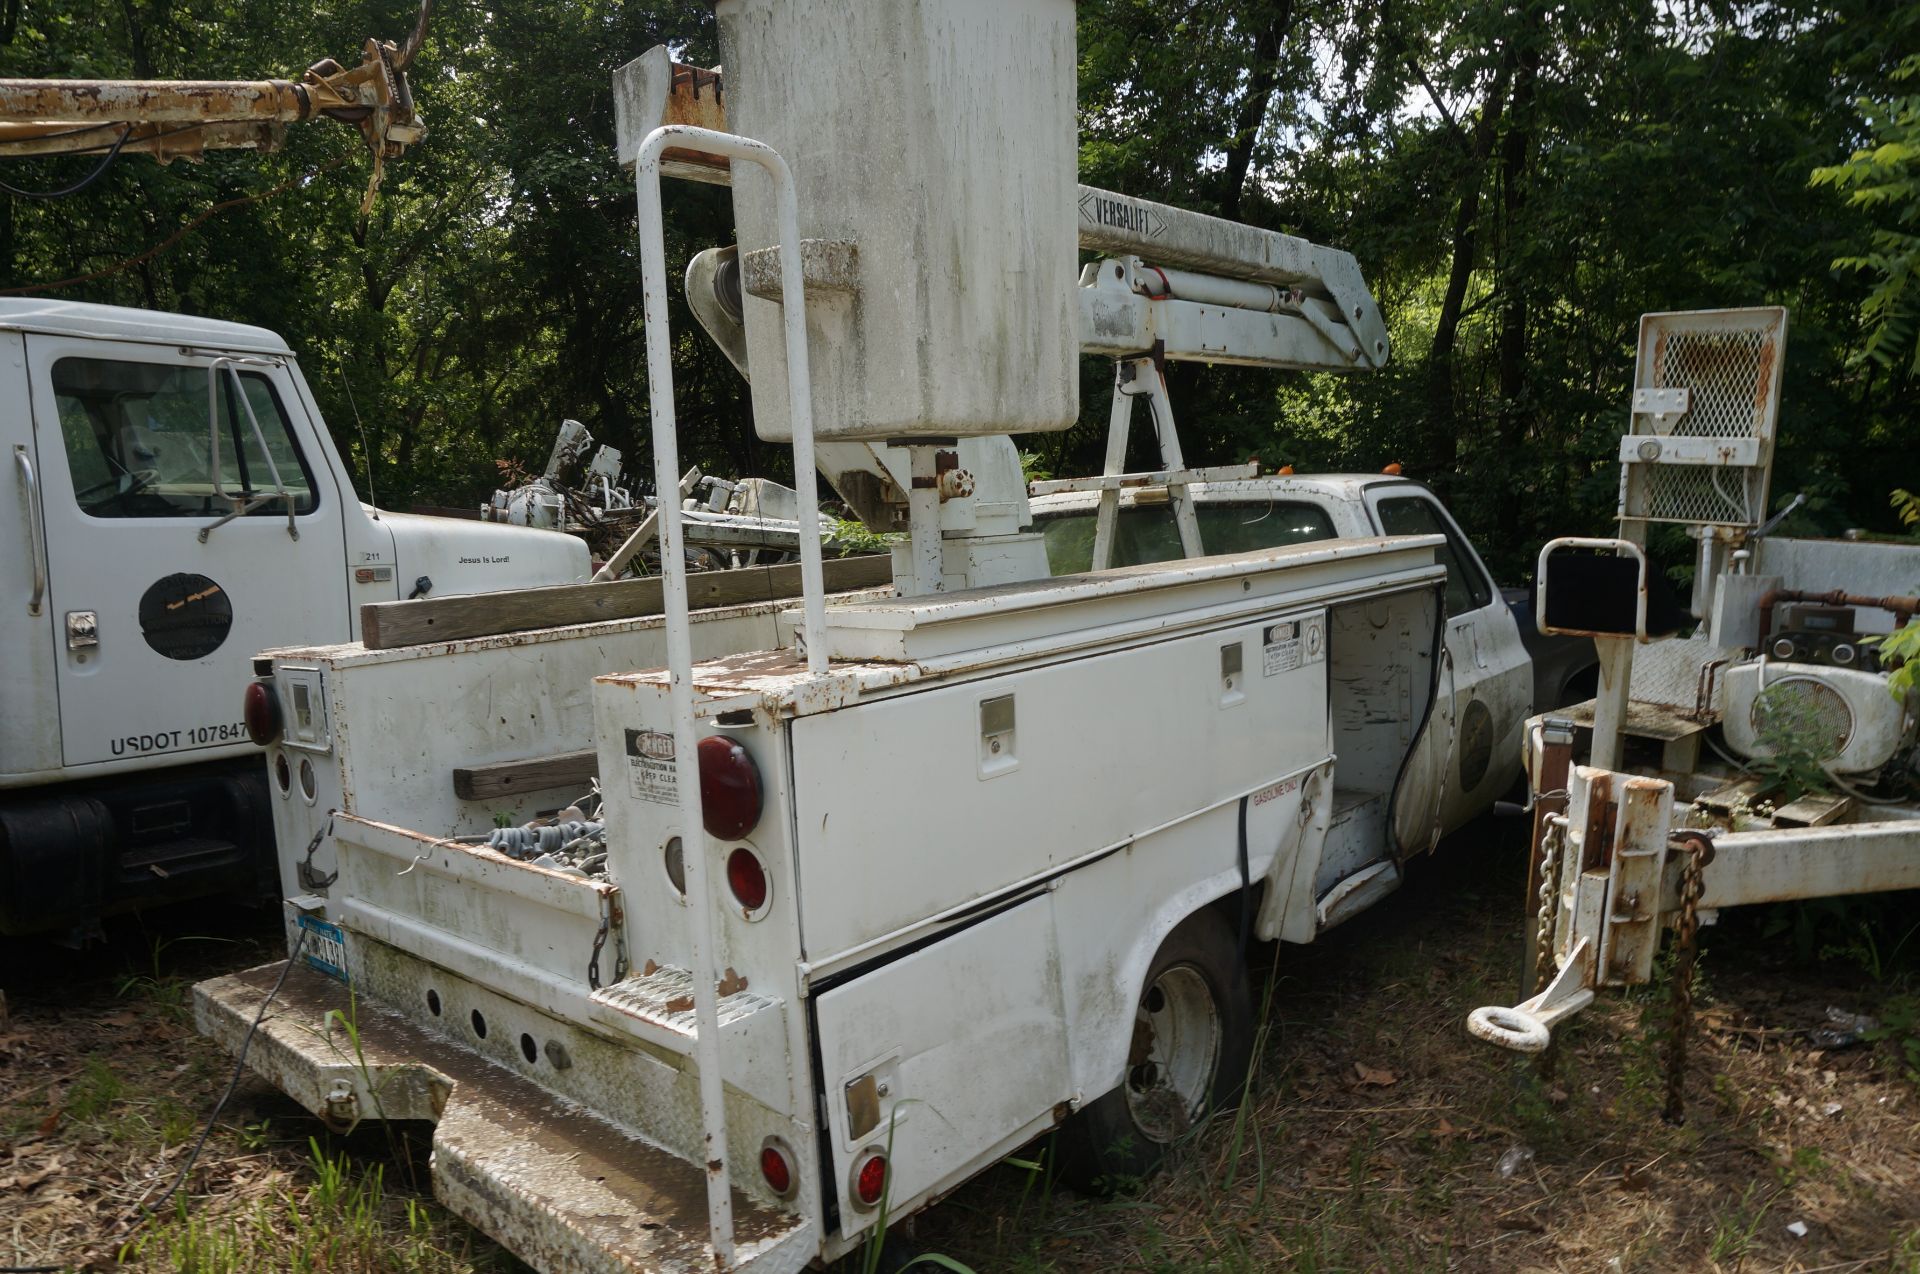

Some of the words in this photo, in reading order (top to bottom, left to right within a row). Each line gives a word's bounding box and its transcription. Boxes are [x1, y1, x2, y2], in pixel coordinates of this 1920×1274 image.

[1095, 197, 1149, 235] VERSALIFT
[458, 556, 481, 564] Jesus
[483, 556, 490, 564] Is
[491, 555, 510, 563] Lord!
[111, 731, 181, 755] USDOT
[188, 722, 248, 745] 107847
[659, 773, 677, 783] CLEA
[1253, 783, 1285, 806] GASOLINE
